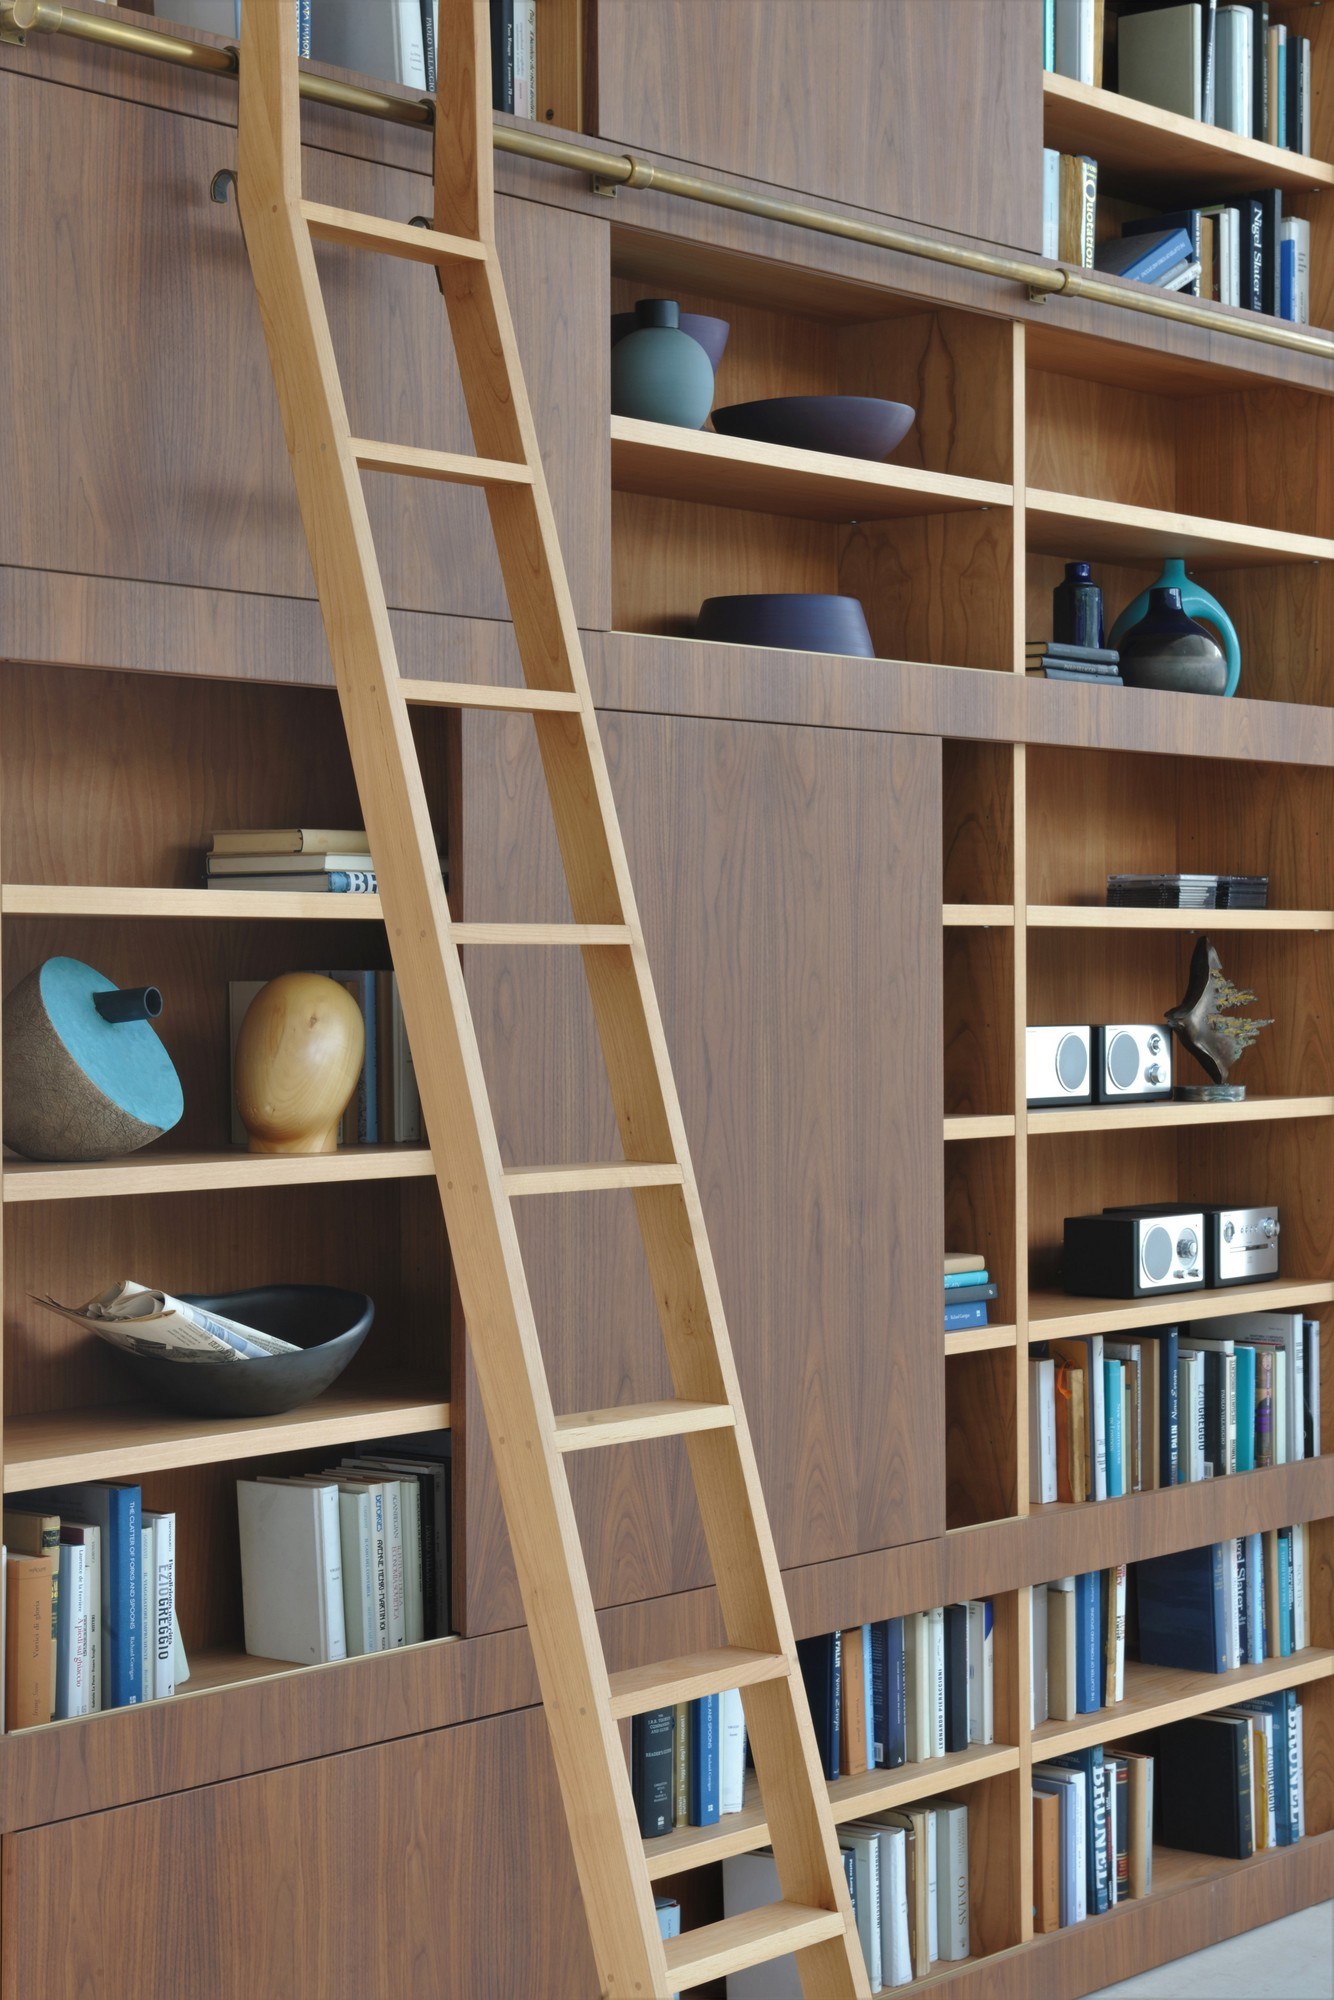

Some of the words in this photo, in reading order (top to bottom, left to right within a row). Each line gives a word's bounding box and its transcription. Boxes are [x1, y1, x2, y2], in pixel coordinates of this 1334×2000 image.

[427, 46, 435, 92] VILLAGGIO
[1251, 207, 1262, 248] Nigel
[1253, 250, 1262, 295] Slater
[129, 1546, 136, 1557] OF
[168, 1559, 174, 1570] Un
[1237, 1567, 1246, 1611] Slater
[73, 1656, 83, 1687] ghiaccio
[1287, 1709, 1299, 1823] BRUNEL
[1092, 1766, 1107, 1889] BRUNEL
